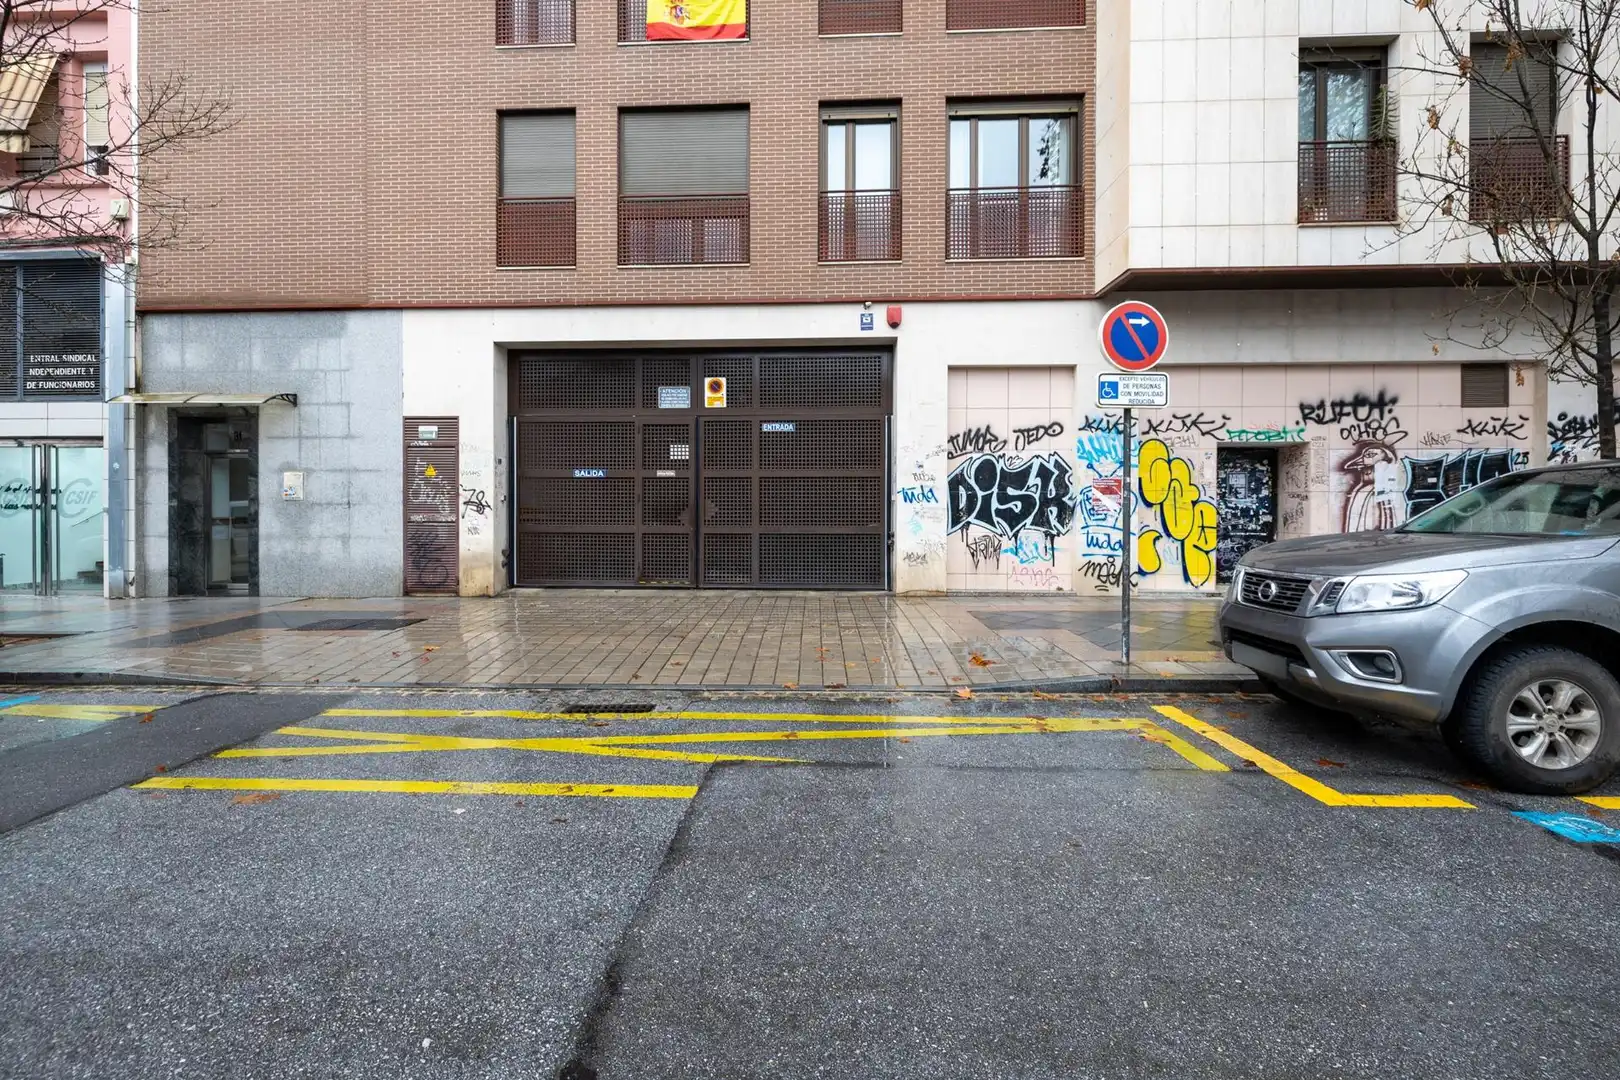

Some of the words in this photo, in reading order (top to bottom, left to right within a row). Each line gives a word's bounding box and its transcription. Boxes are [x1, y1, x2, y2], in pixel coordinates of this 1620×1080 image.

[62, 354, 96, 362] SINDICAL
[29, 367, 86, 376] NDEPENDIENTE
[89, 367, 94, 375] Y
[26, 381, 37, 389] DE
[38, 380, 96, 389] FUNCIONARIOS
[763, 423, 794, 431] ENTRADA
[574, 469, 604, 477] SALIDA
[65, 490, 98, 505] CSIF
